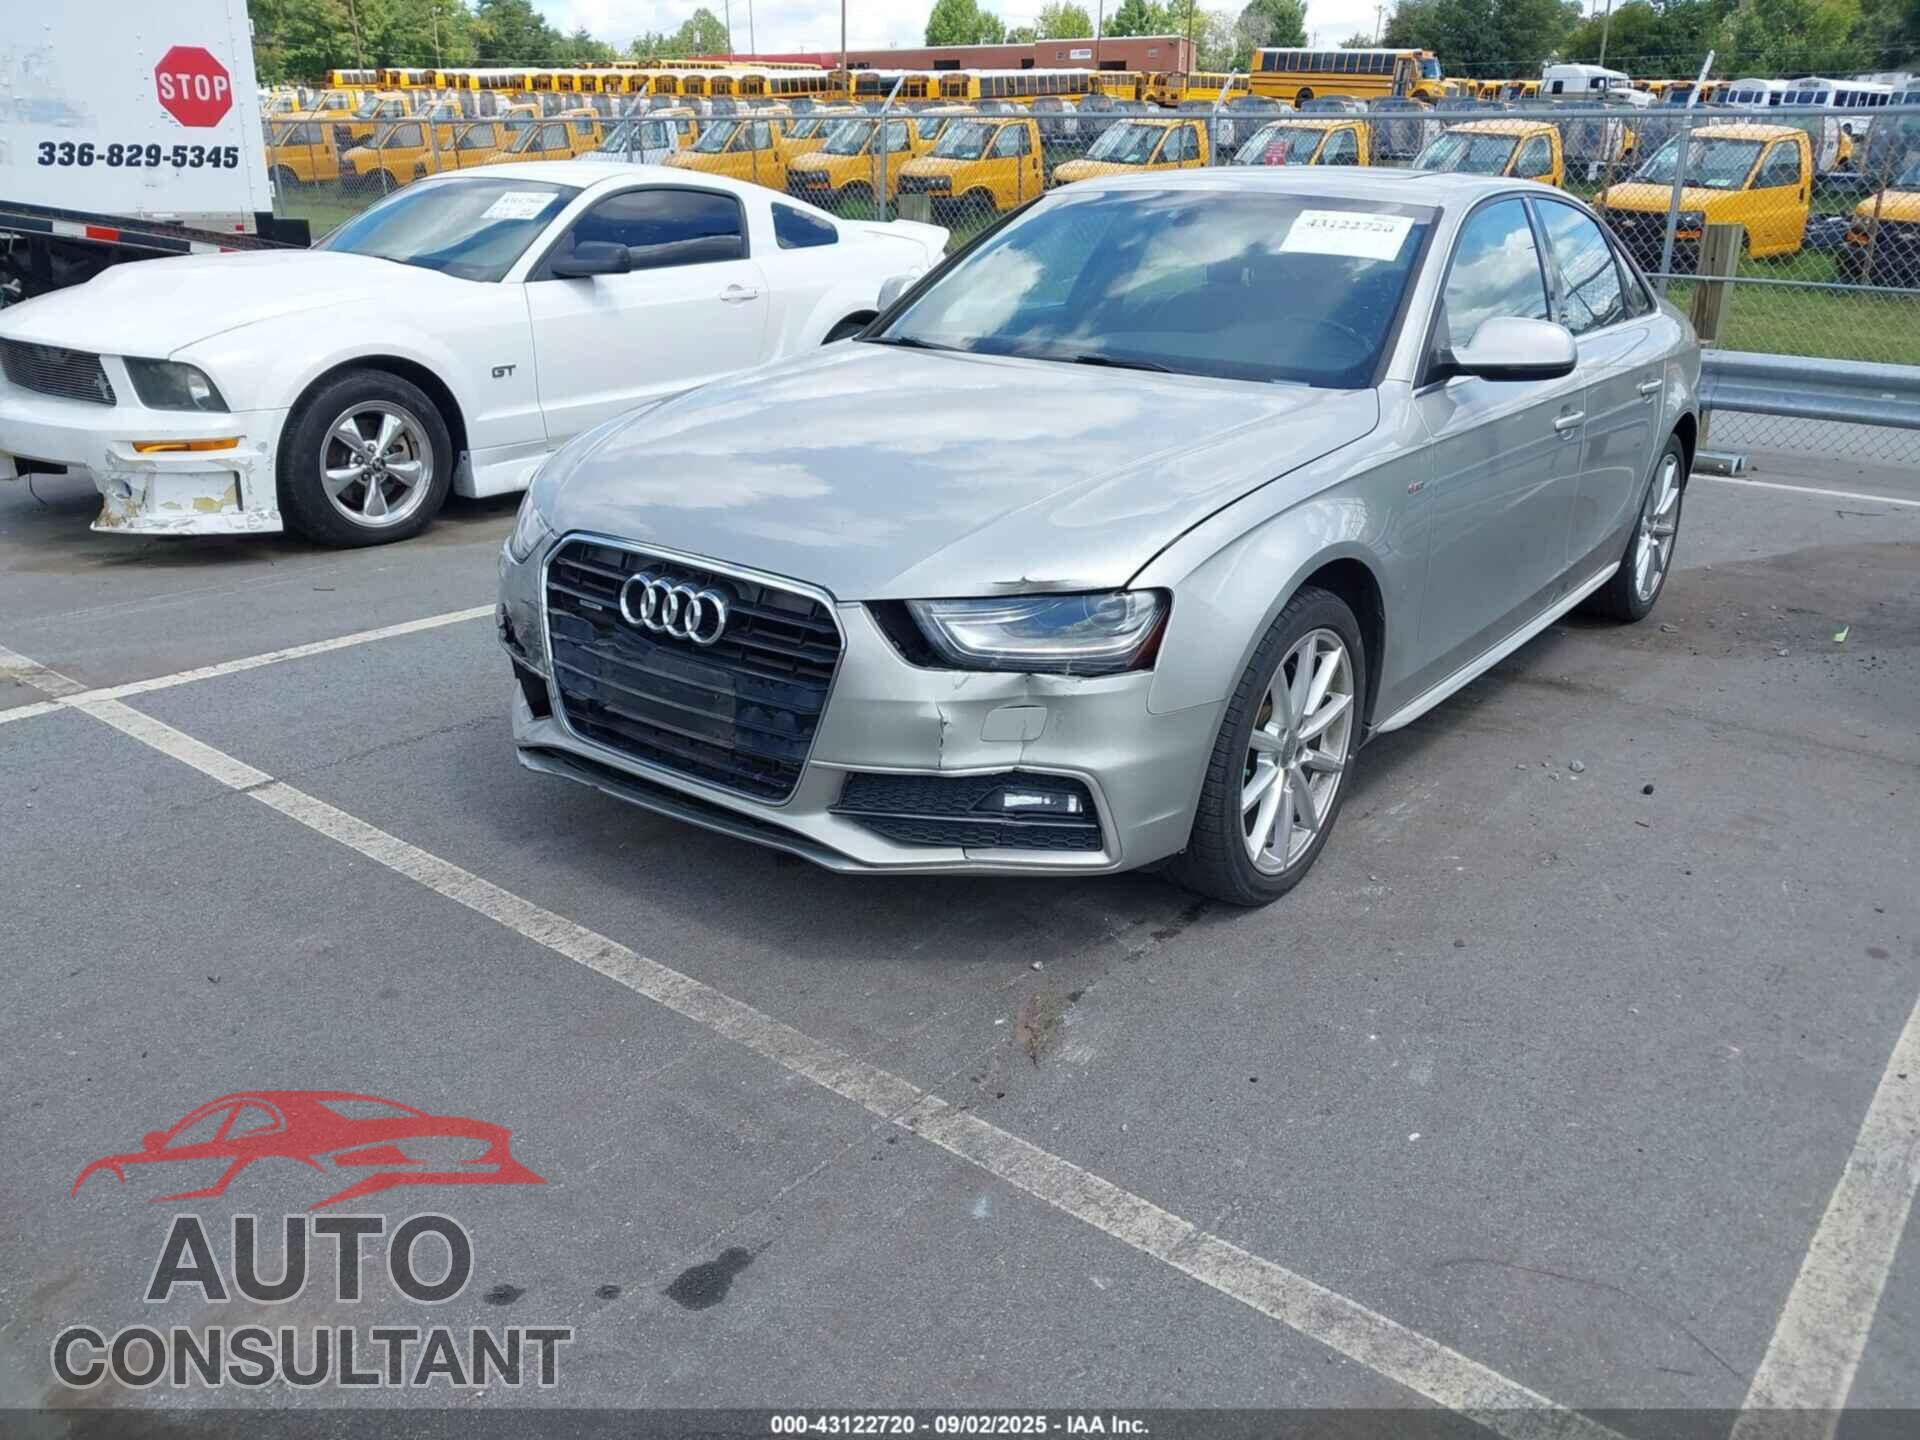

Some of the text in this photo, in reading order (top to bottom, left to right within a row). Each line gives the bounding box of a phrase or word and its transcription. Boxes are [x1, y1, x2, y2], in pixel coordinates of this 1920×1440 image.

[159, 72, 228, 101] STOP
[37, 141, 240, 169] 336-829-5345
[492, 364, 517, 378] GT
